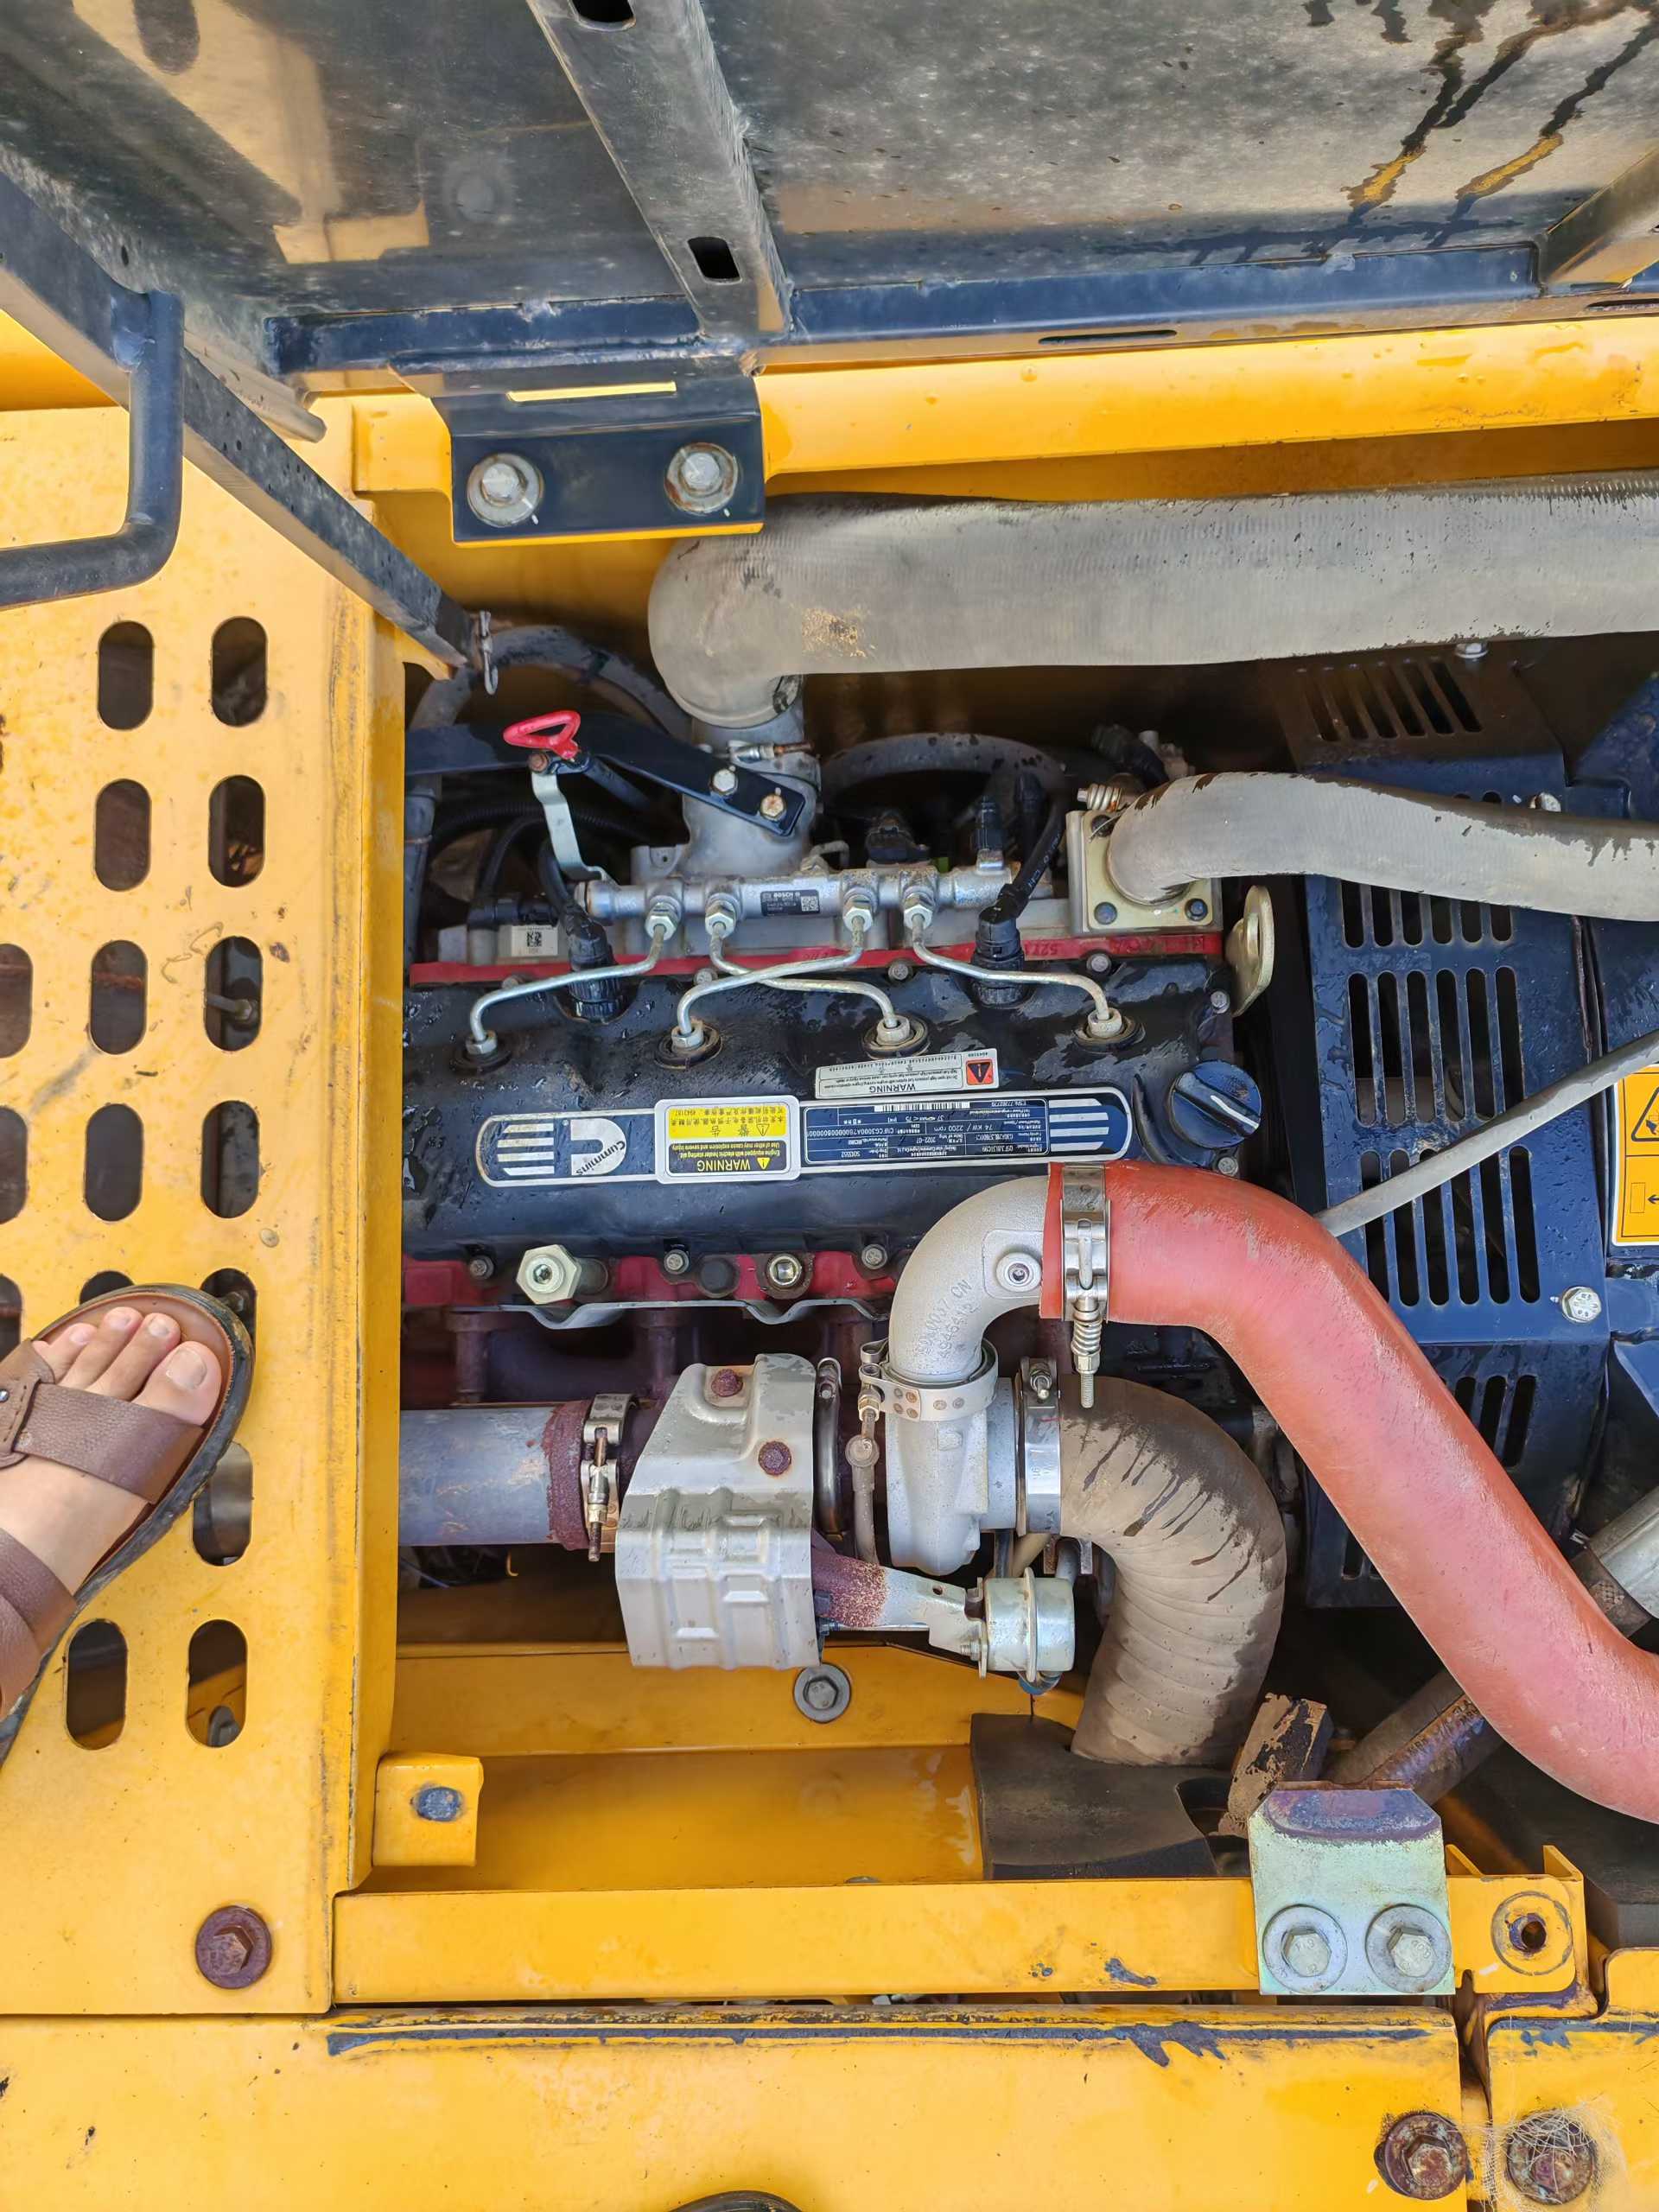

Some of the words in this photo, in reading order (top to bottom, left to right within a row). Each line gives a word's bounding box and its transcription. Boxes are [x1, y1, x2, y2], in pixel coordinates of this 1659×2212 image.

[869, 1084, 916, 1092] WARNING
[575, 1141, 626, 1175] Cummins
[696, 1160, 751, 1172] WARNING
